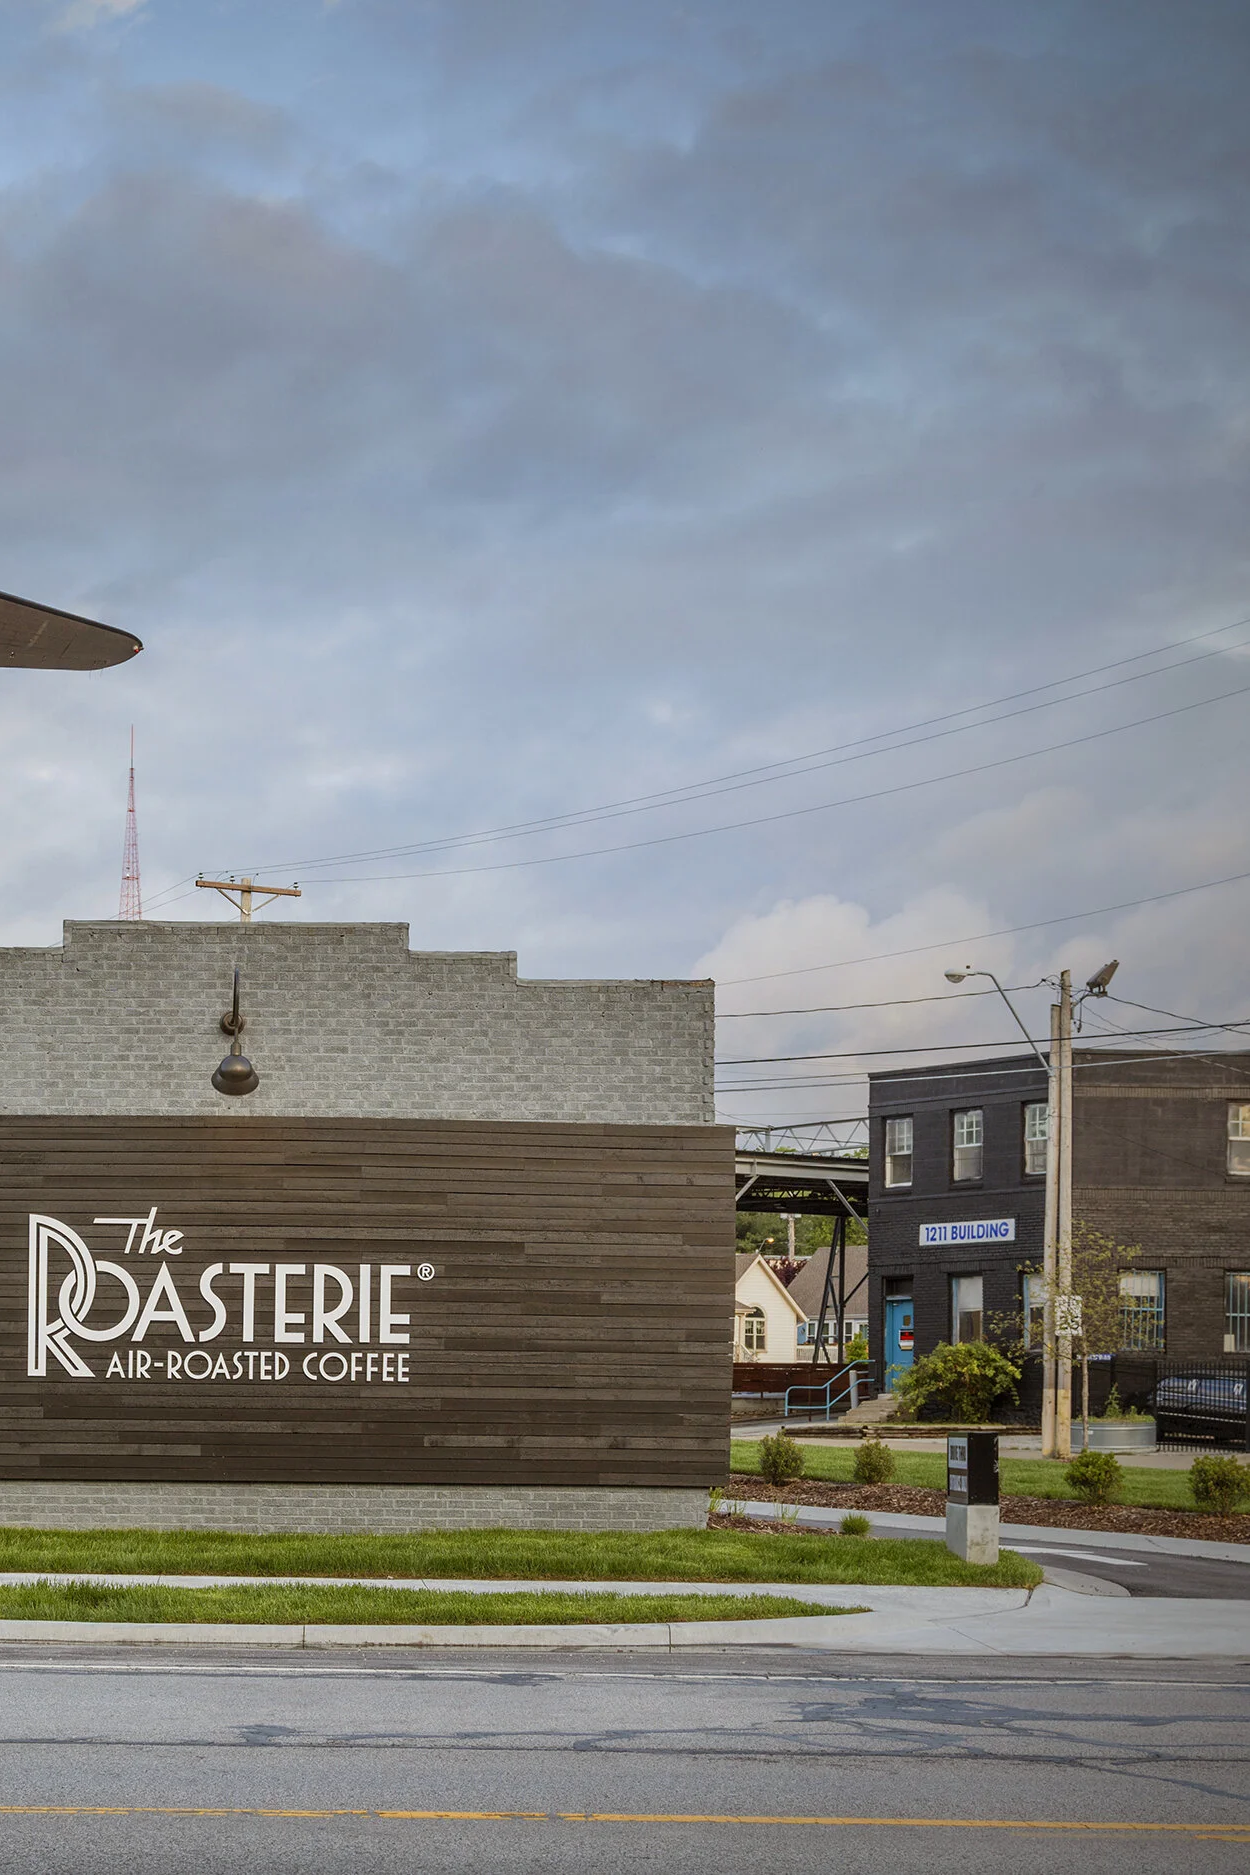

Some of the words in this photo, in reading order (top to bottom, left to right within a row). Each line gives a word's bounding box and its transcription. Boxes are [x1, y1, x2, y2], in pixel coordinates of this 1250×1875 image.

[93, 1206, 185, 1255] The
[925, 1226, 947, 1242] 1211
[951, 1222, 1010, 1240] BUILDING
[105, 1349, 291, 1380] AIR-ROASTED
[302, 1352, 411, 1382] COFFEE
